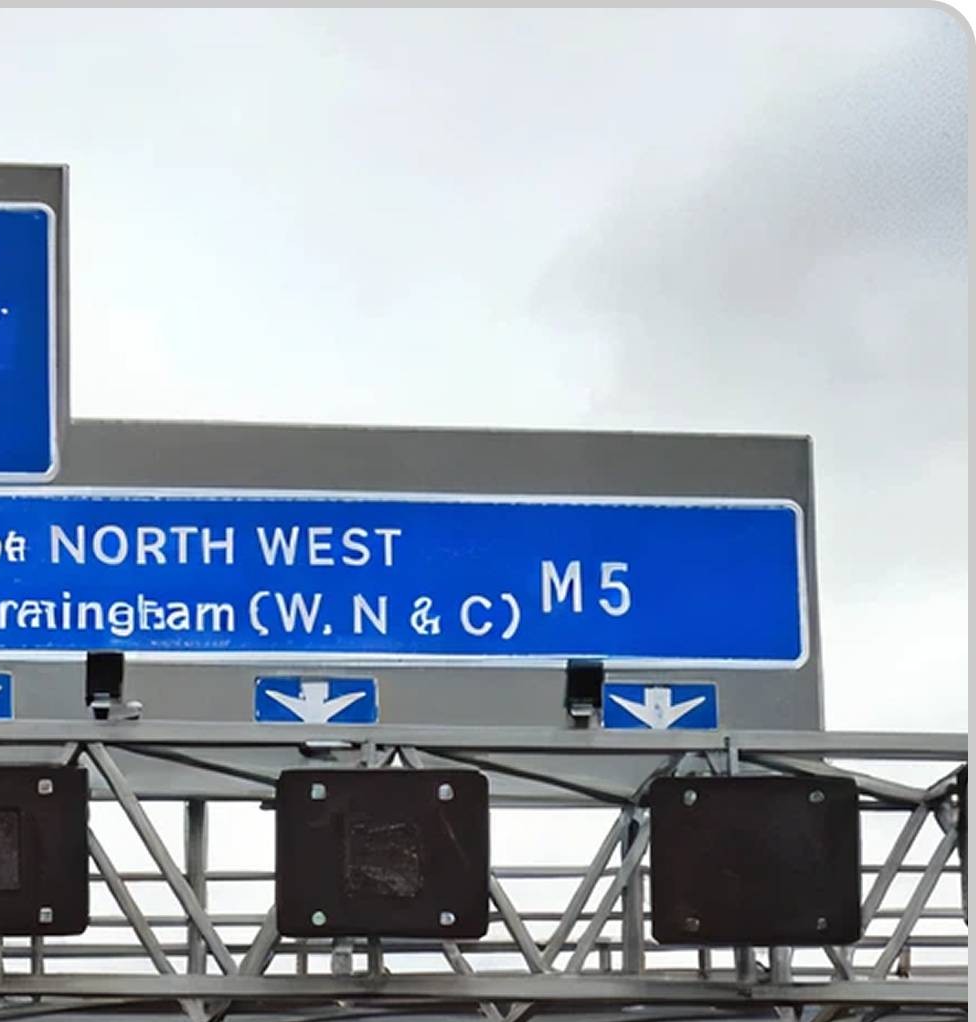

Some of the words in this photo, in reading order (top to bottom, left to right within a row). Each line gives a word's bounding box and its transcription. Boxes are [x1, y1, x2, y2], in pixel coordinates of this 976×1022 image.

[50, 524, 235, 565] NORTH
[256, 526, 402, 566] WEST
[353, 593, 387, 634] N
[410, 596, 441, 635] &
[460, 593, 522, 639] C)
